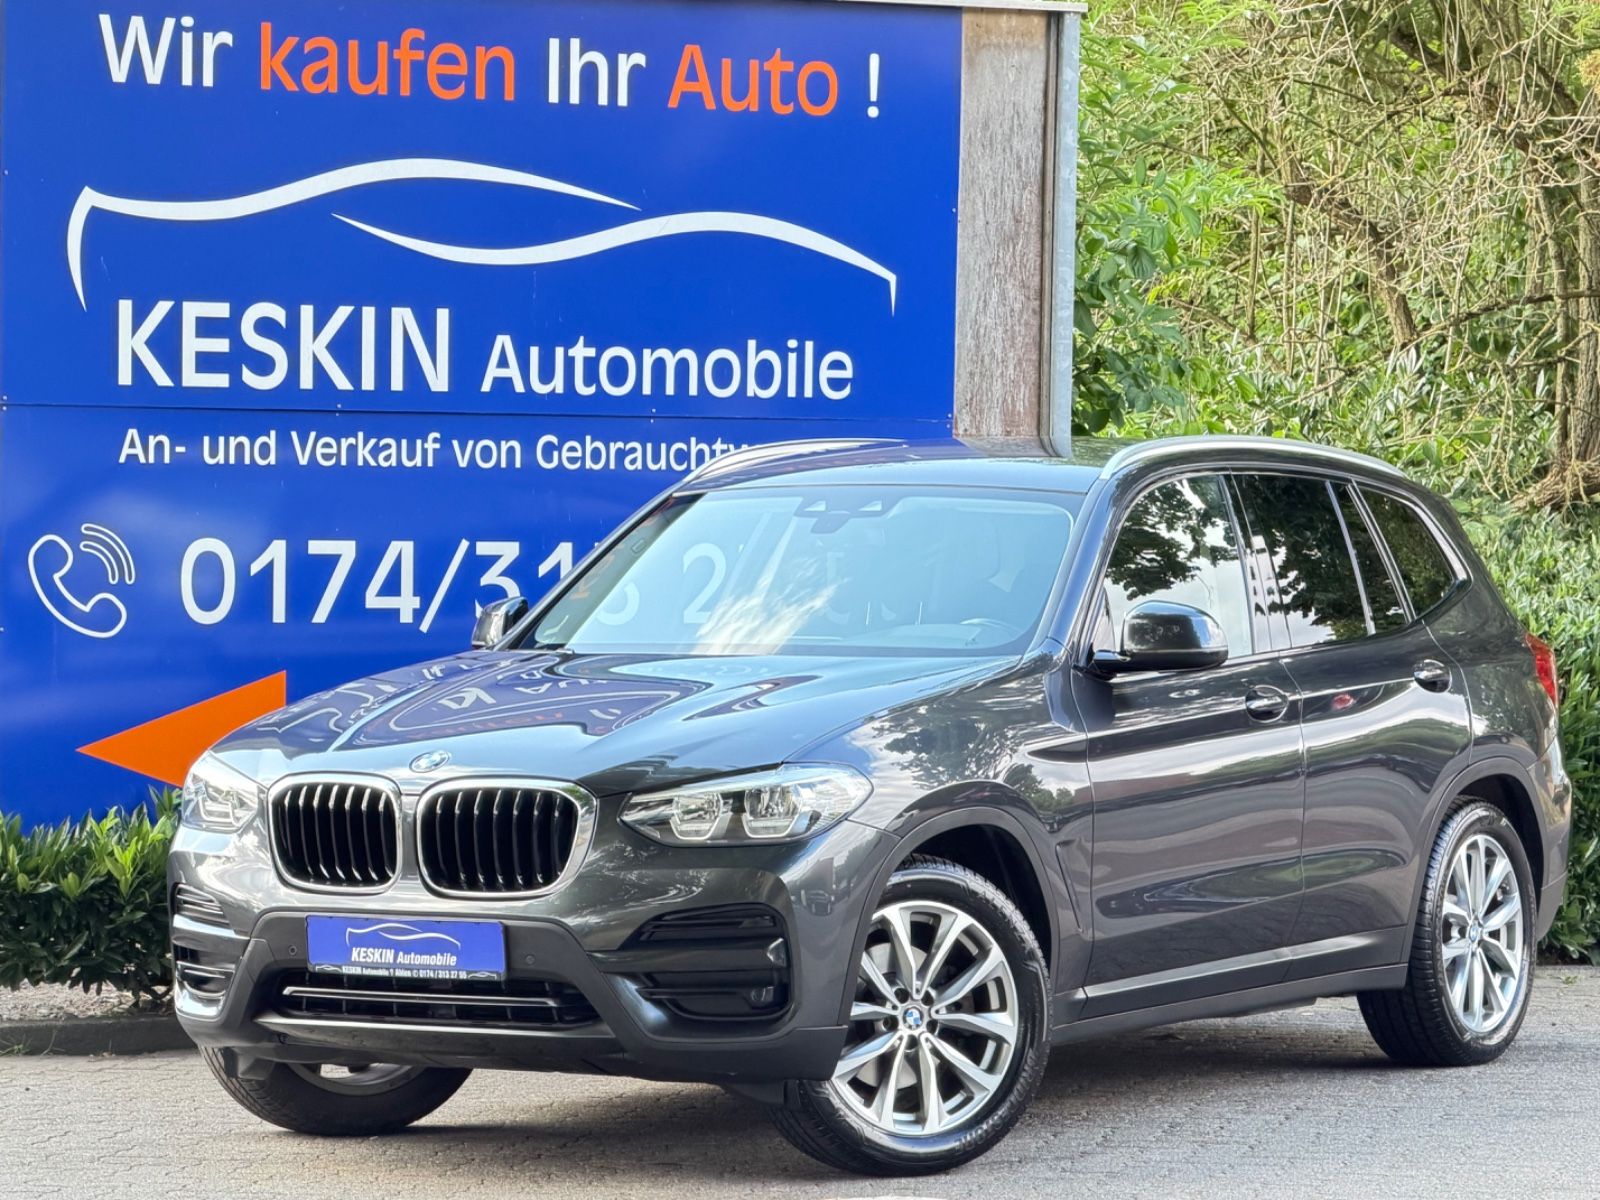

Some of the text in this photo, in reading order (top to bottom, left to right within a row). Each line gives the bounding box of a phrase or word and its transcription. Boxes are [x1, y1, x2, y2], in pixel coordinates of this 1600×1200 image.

[99, 13, 880, 119] Wir kaufen Ihr Auto !
[117, 298, 854, 400] KESKIN Automobile
[119, 427, 748, 472] An- und Verkauf von Gebraucht
[342, 965, 362, 975] KESKIN
[351, 947, 457, 967] KESKIN Automobile
